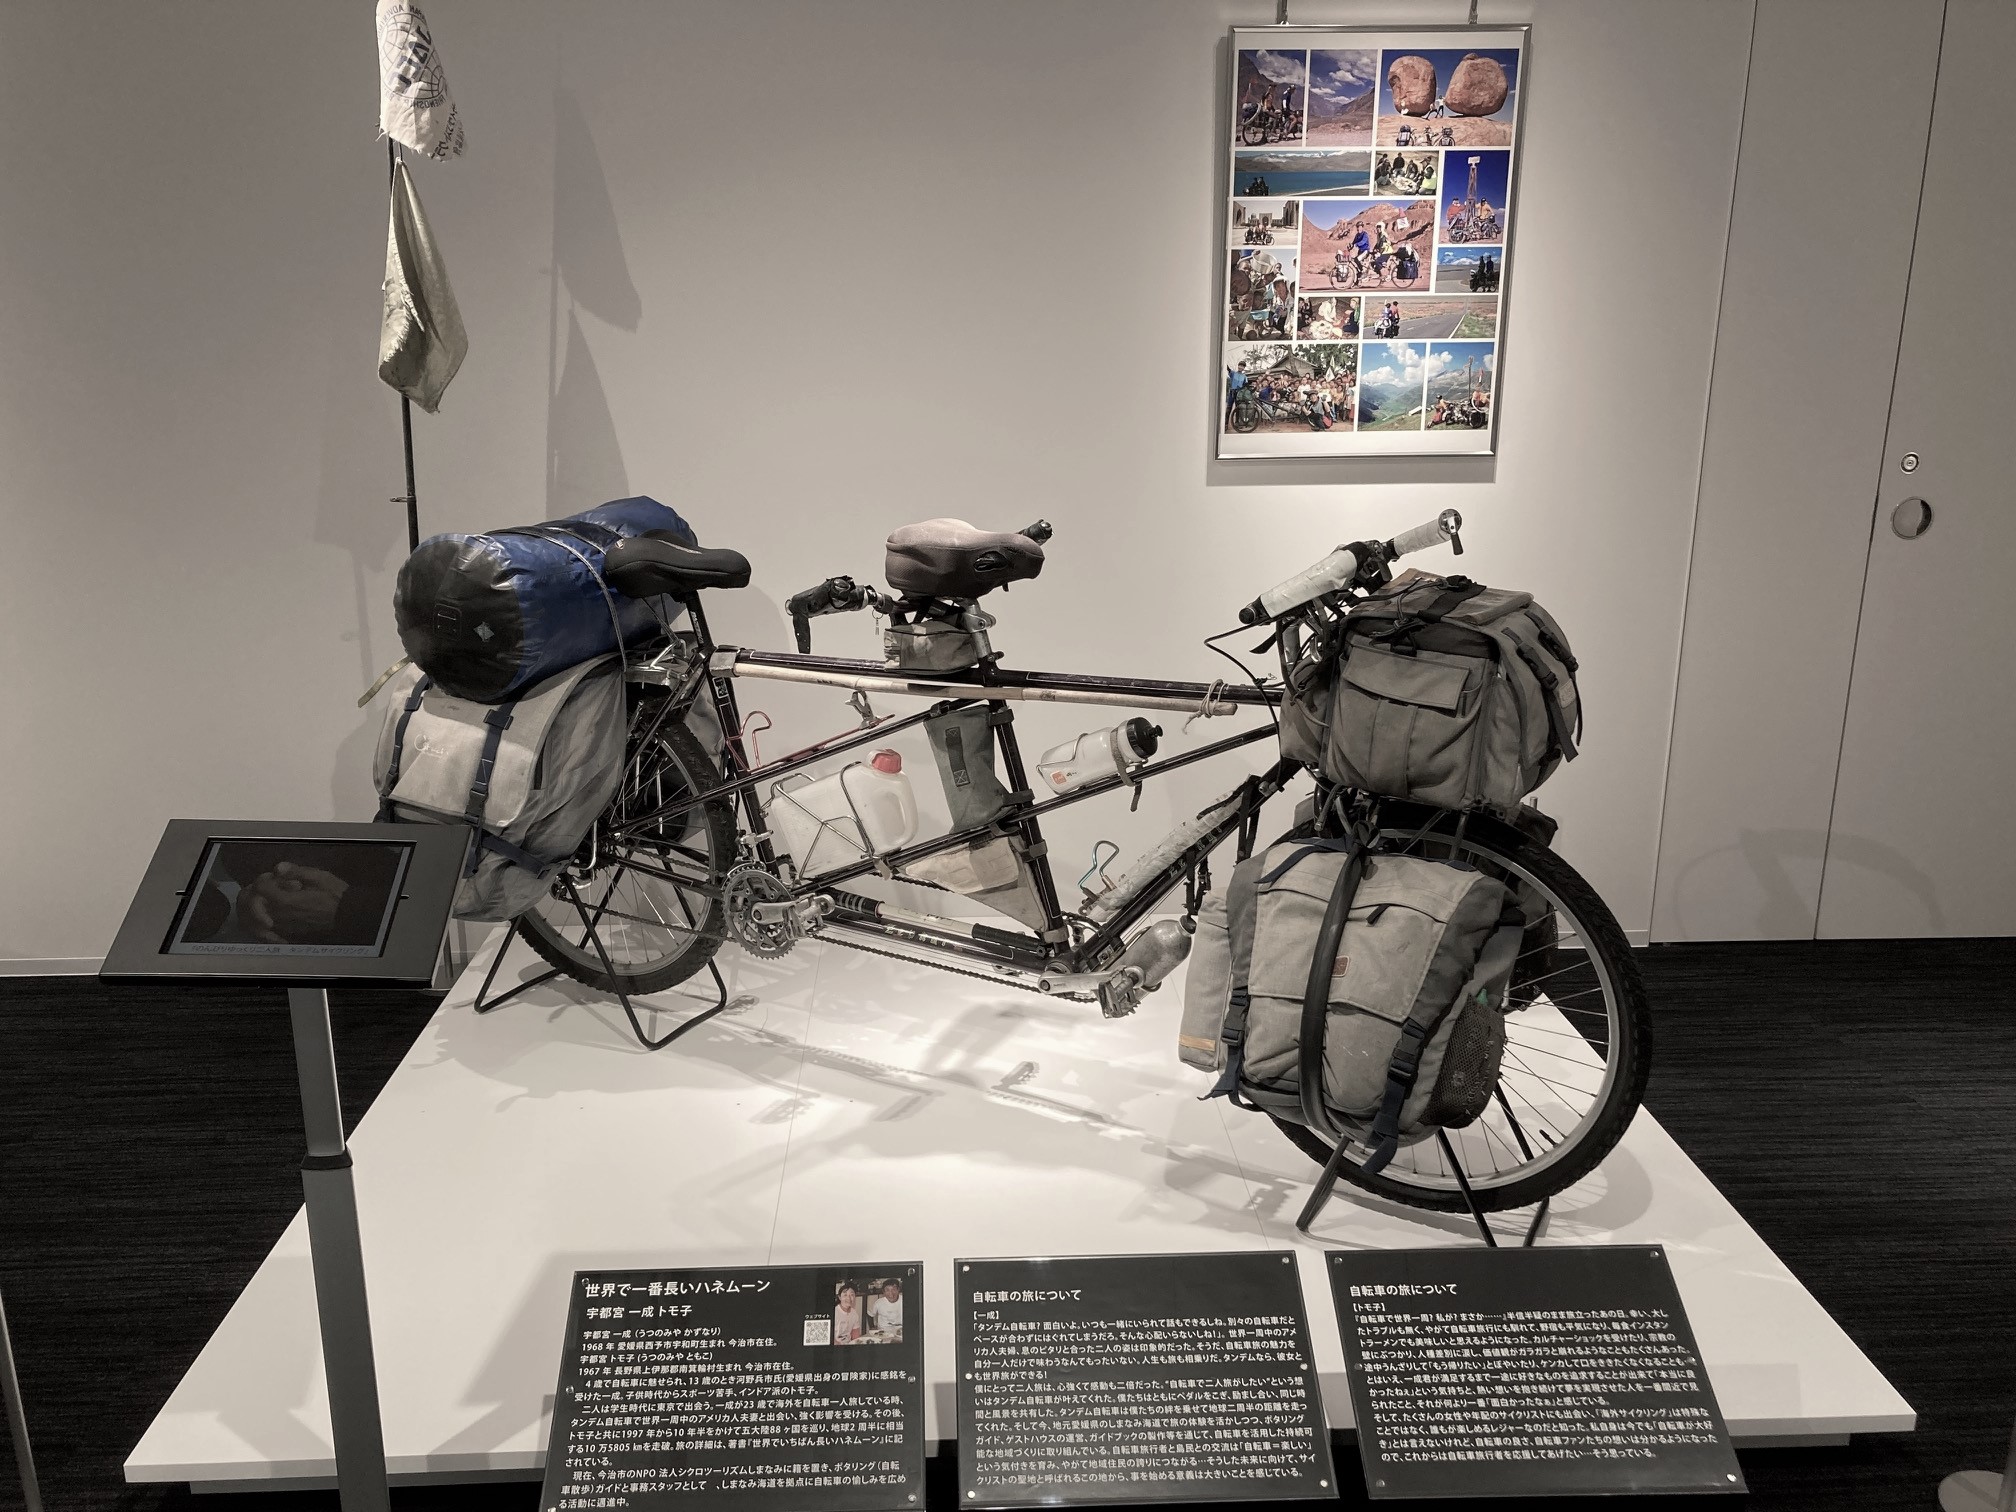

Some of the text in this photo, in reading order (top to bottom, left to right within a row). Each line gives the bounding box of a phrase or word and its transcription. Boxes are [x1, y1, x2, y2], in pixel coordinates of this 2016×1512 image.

[585, 1280, 770, 1297] 世界で一番長いハネムーン
[1350, 1284, 1457, 1297] 自転車の旅について
[973, 1289, 1082, 1303] 自転車の旅について
[587, 1306, 624, 1320] 宇都宮
[566, 1456, 612, 1468] されている。
